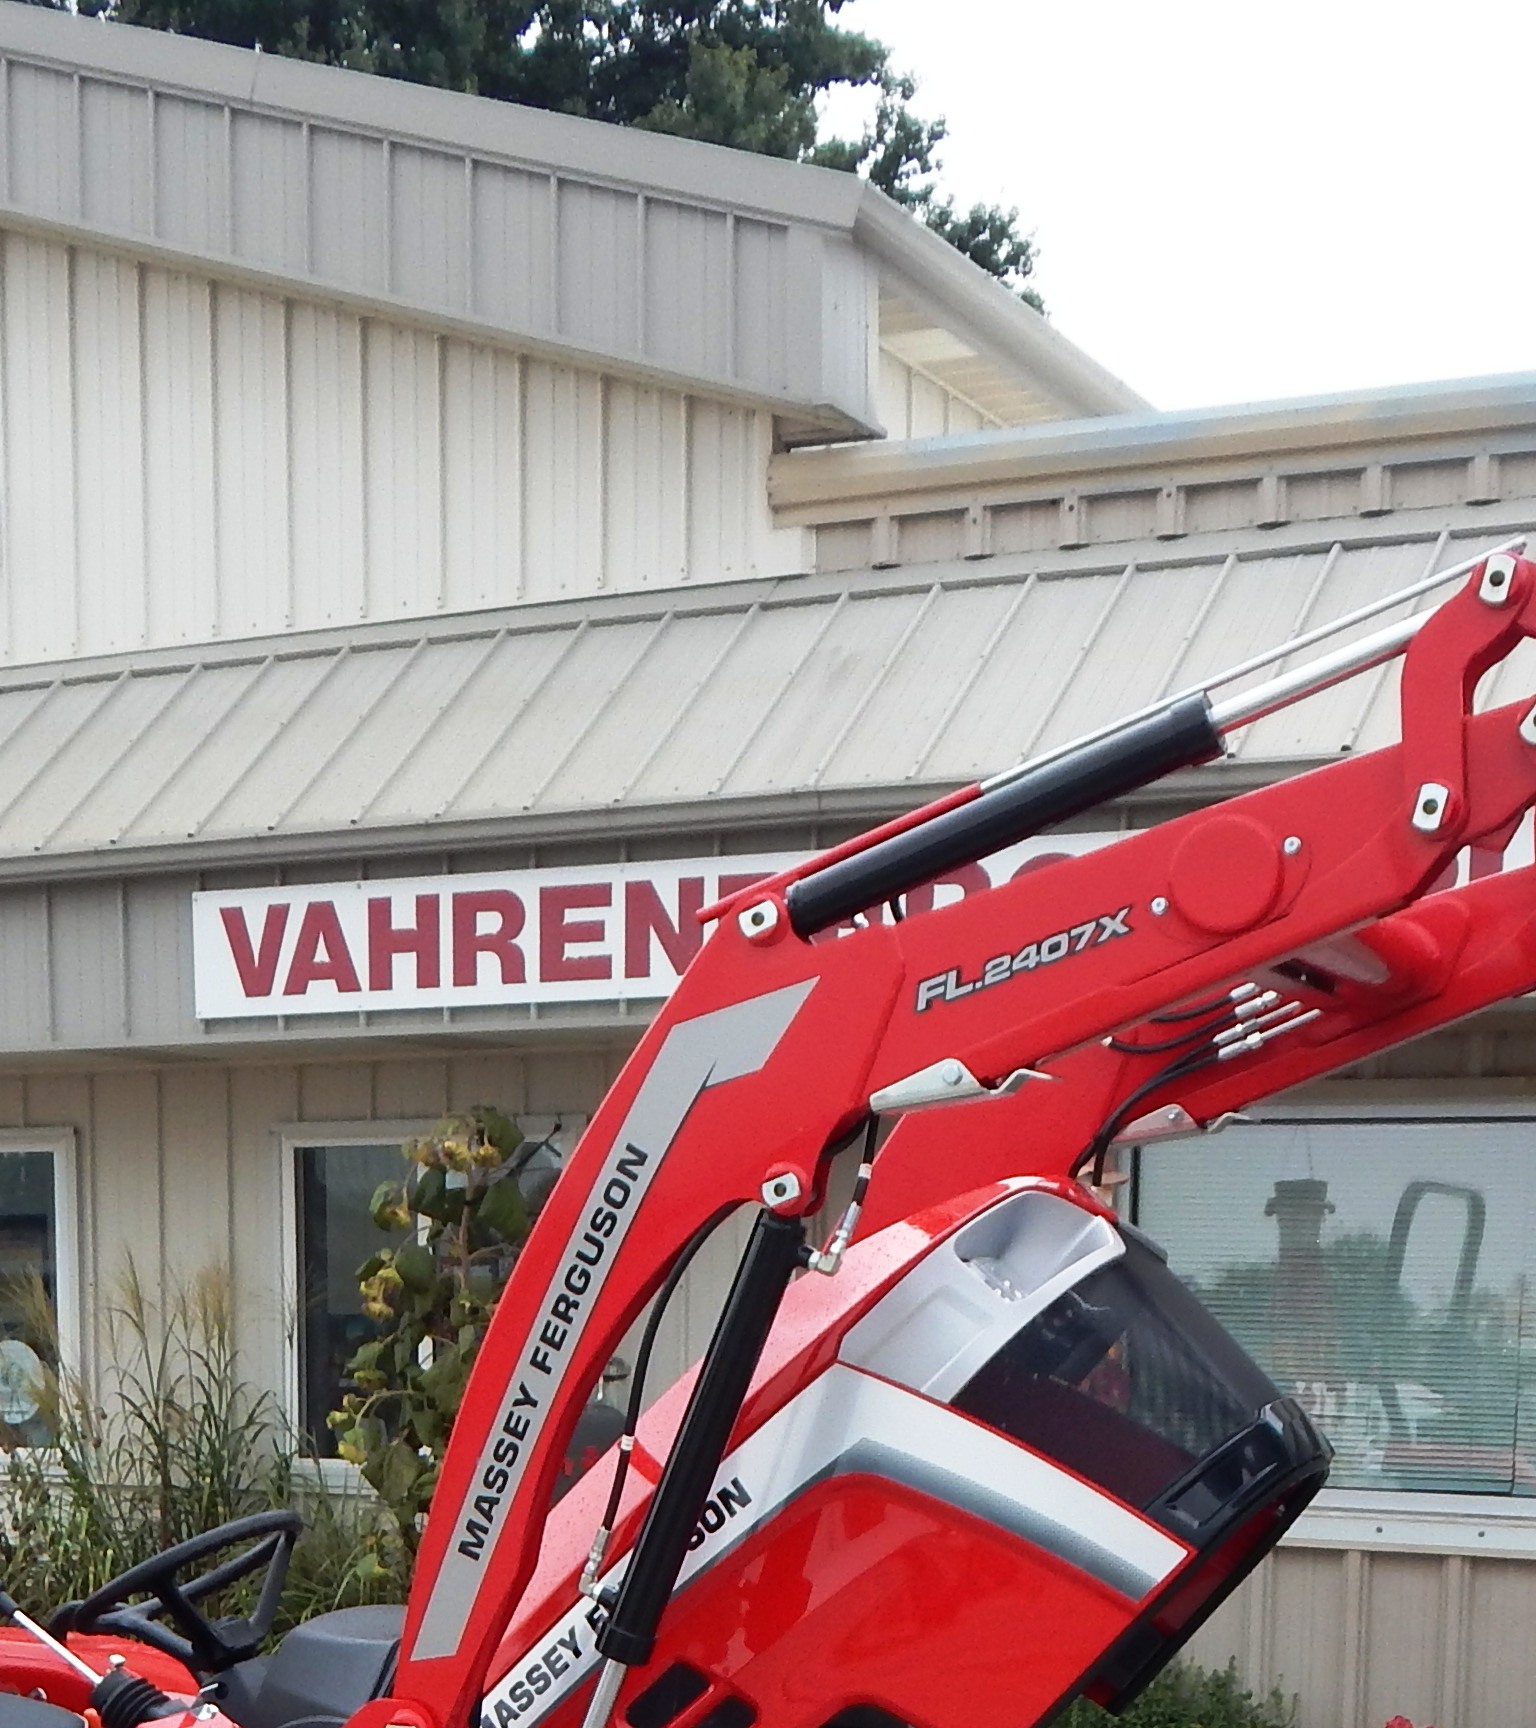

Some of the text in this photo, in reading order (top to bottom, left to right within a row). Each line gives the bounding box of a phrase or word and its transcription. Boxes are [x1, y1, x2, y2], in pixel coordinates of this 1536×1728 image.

[916, 905, 1133, 1013] FL.2407X
[457, 1141, 649, 1561] MASSEY FERGUSON
